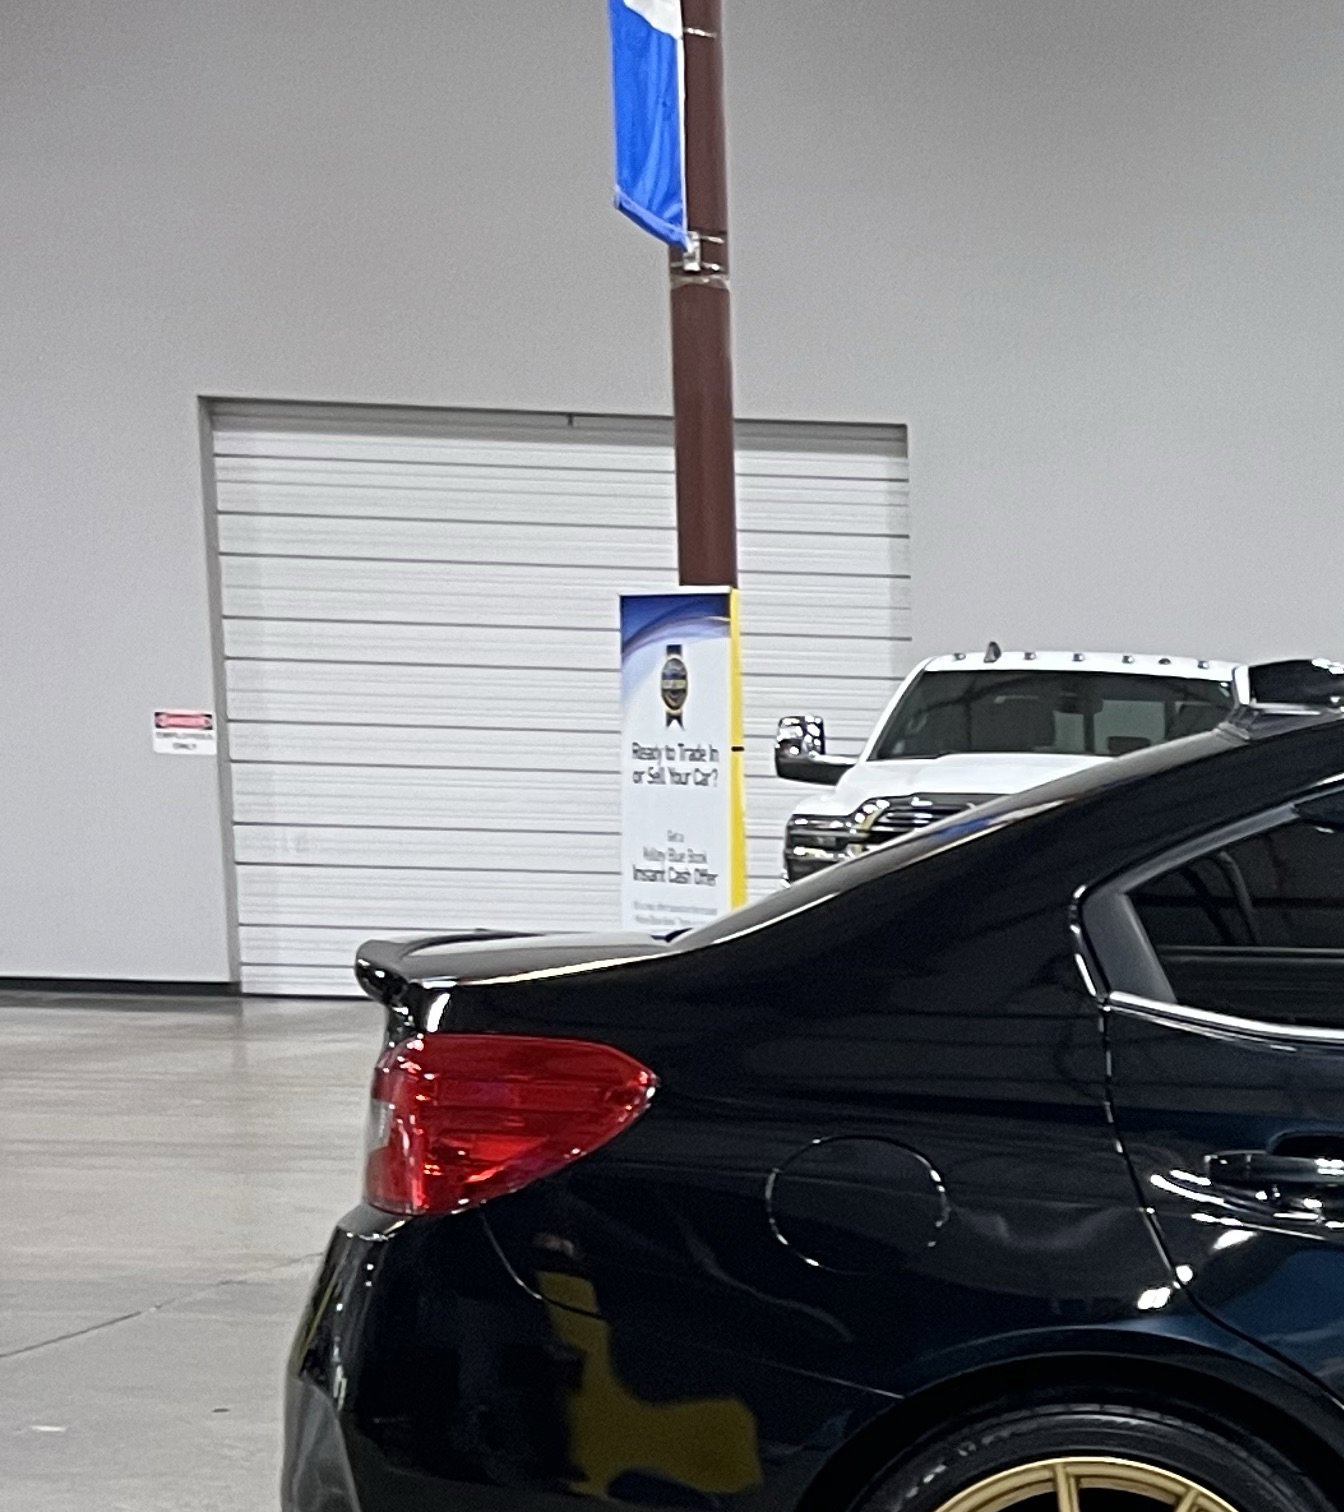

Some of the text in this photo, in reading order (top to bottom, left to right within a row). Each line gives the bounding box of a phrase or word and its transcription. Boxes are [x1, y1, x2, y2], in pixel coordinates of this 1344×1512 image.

[631, 741, 720, 766] Ready to Trade In
[632, 766, 719, 788] or Sell Your Car?
[632, 864, 719, 888] Instant Cash Offer
